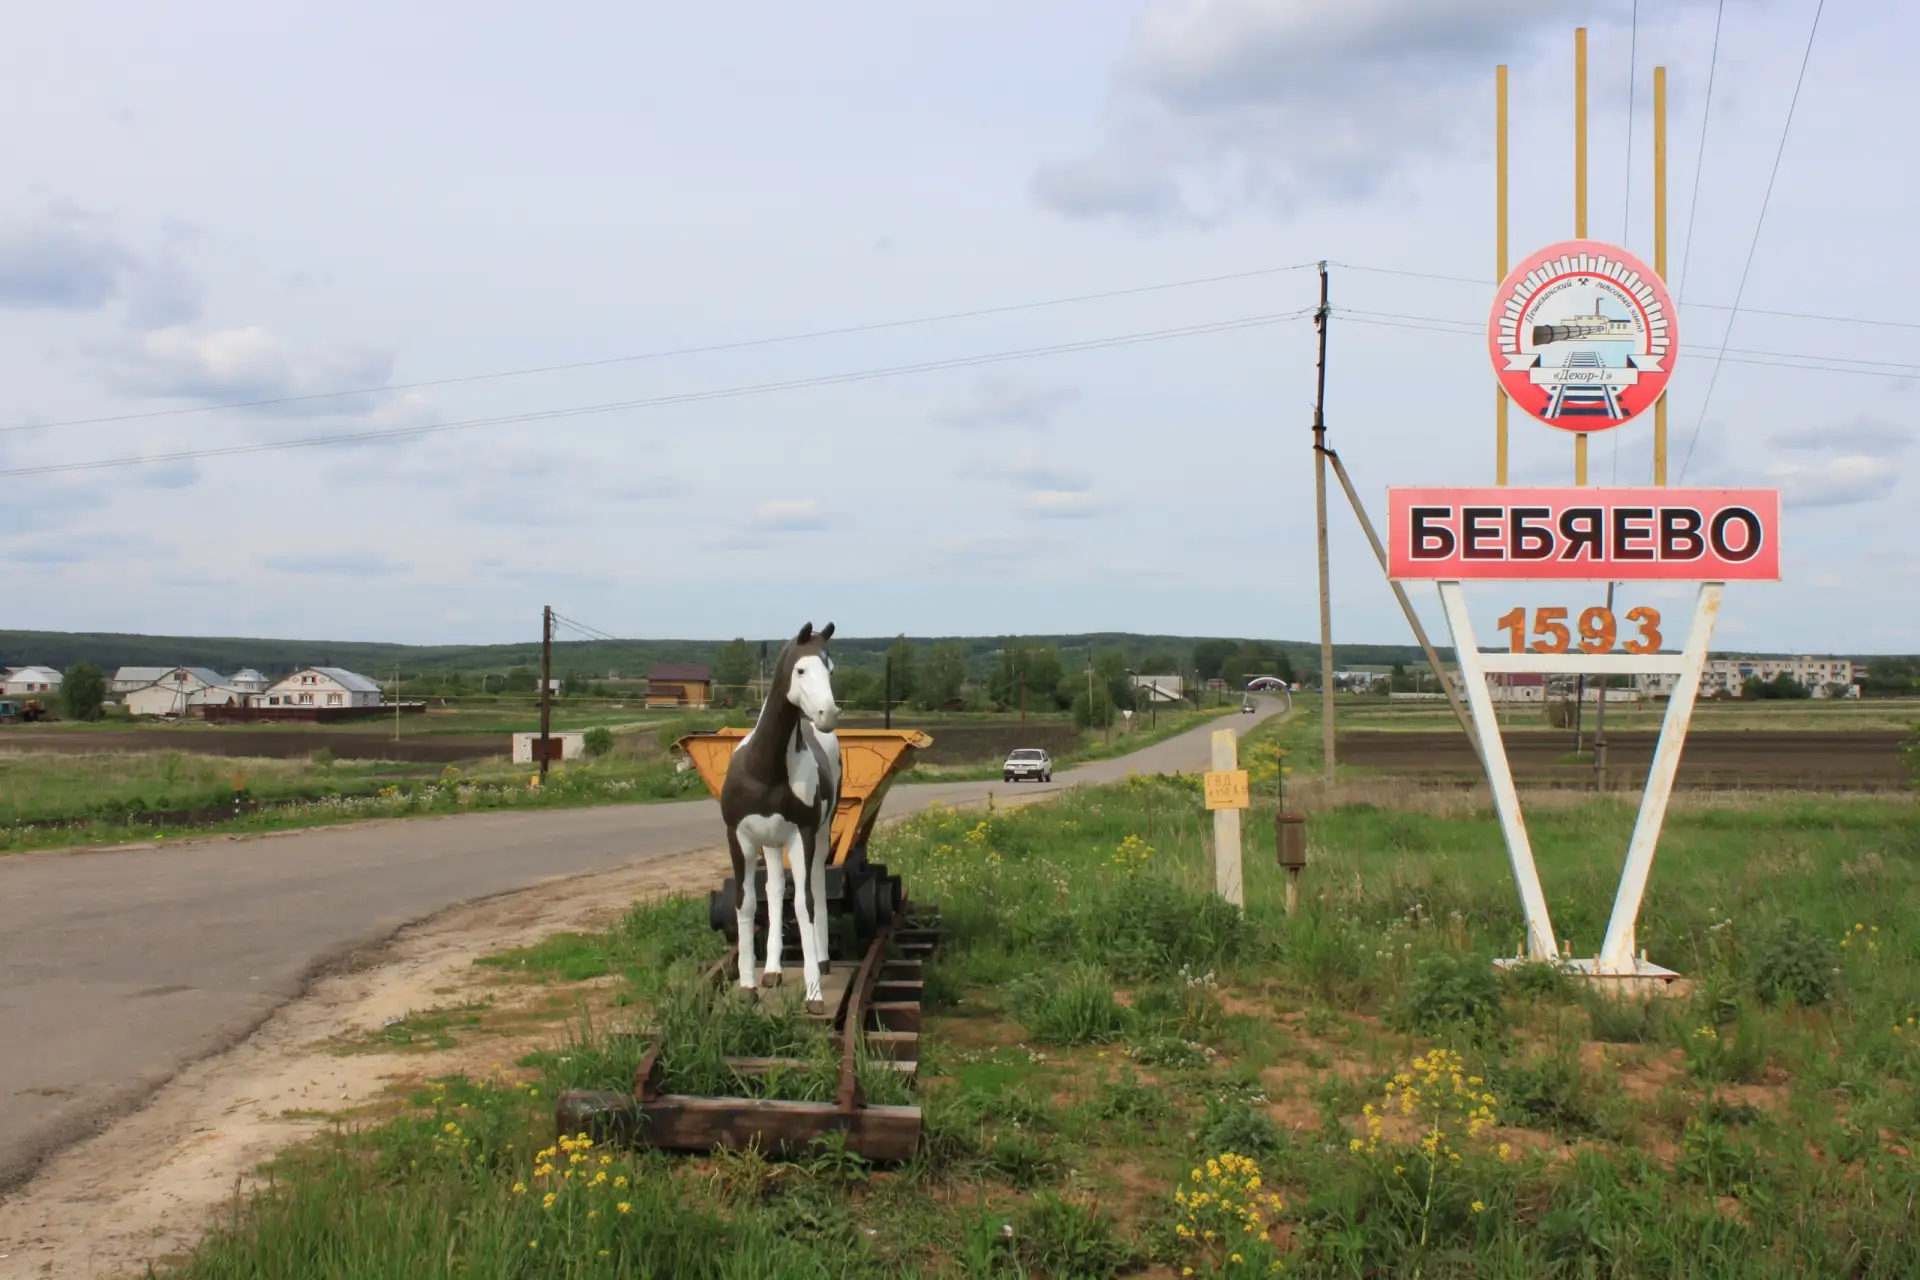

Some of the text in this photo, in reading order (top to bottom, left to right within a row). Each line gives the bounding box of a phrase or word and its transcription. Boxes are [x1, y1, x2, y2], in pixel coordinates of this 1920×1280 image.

[1595, 281, 1632, 309] гипсовый
[1630, 308, 1645, 333] завод
[1553, 369, 1612, 382] «Декор-1»
[1409, 505, 1763, 564] БЕБЯЕВО
[1497, 606, 1663, 655] 1593
